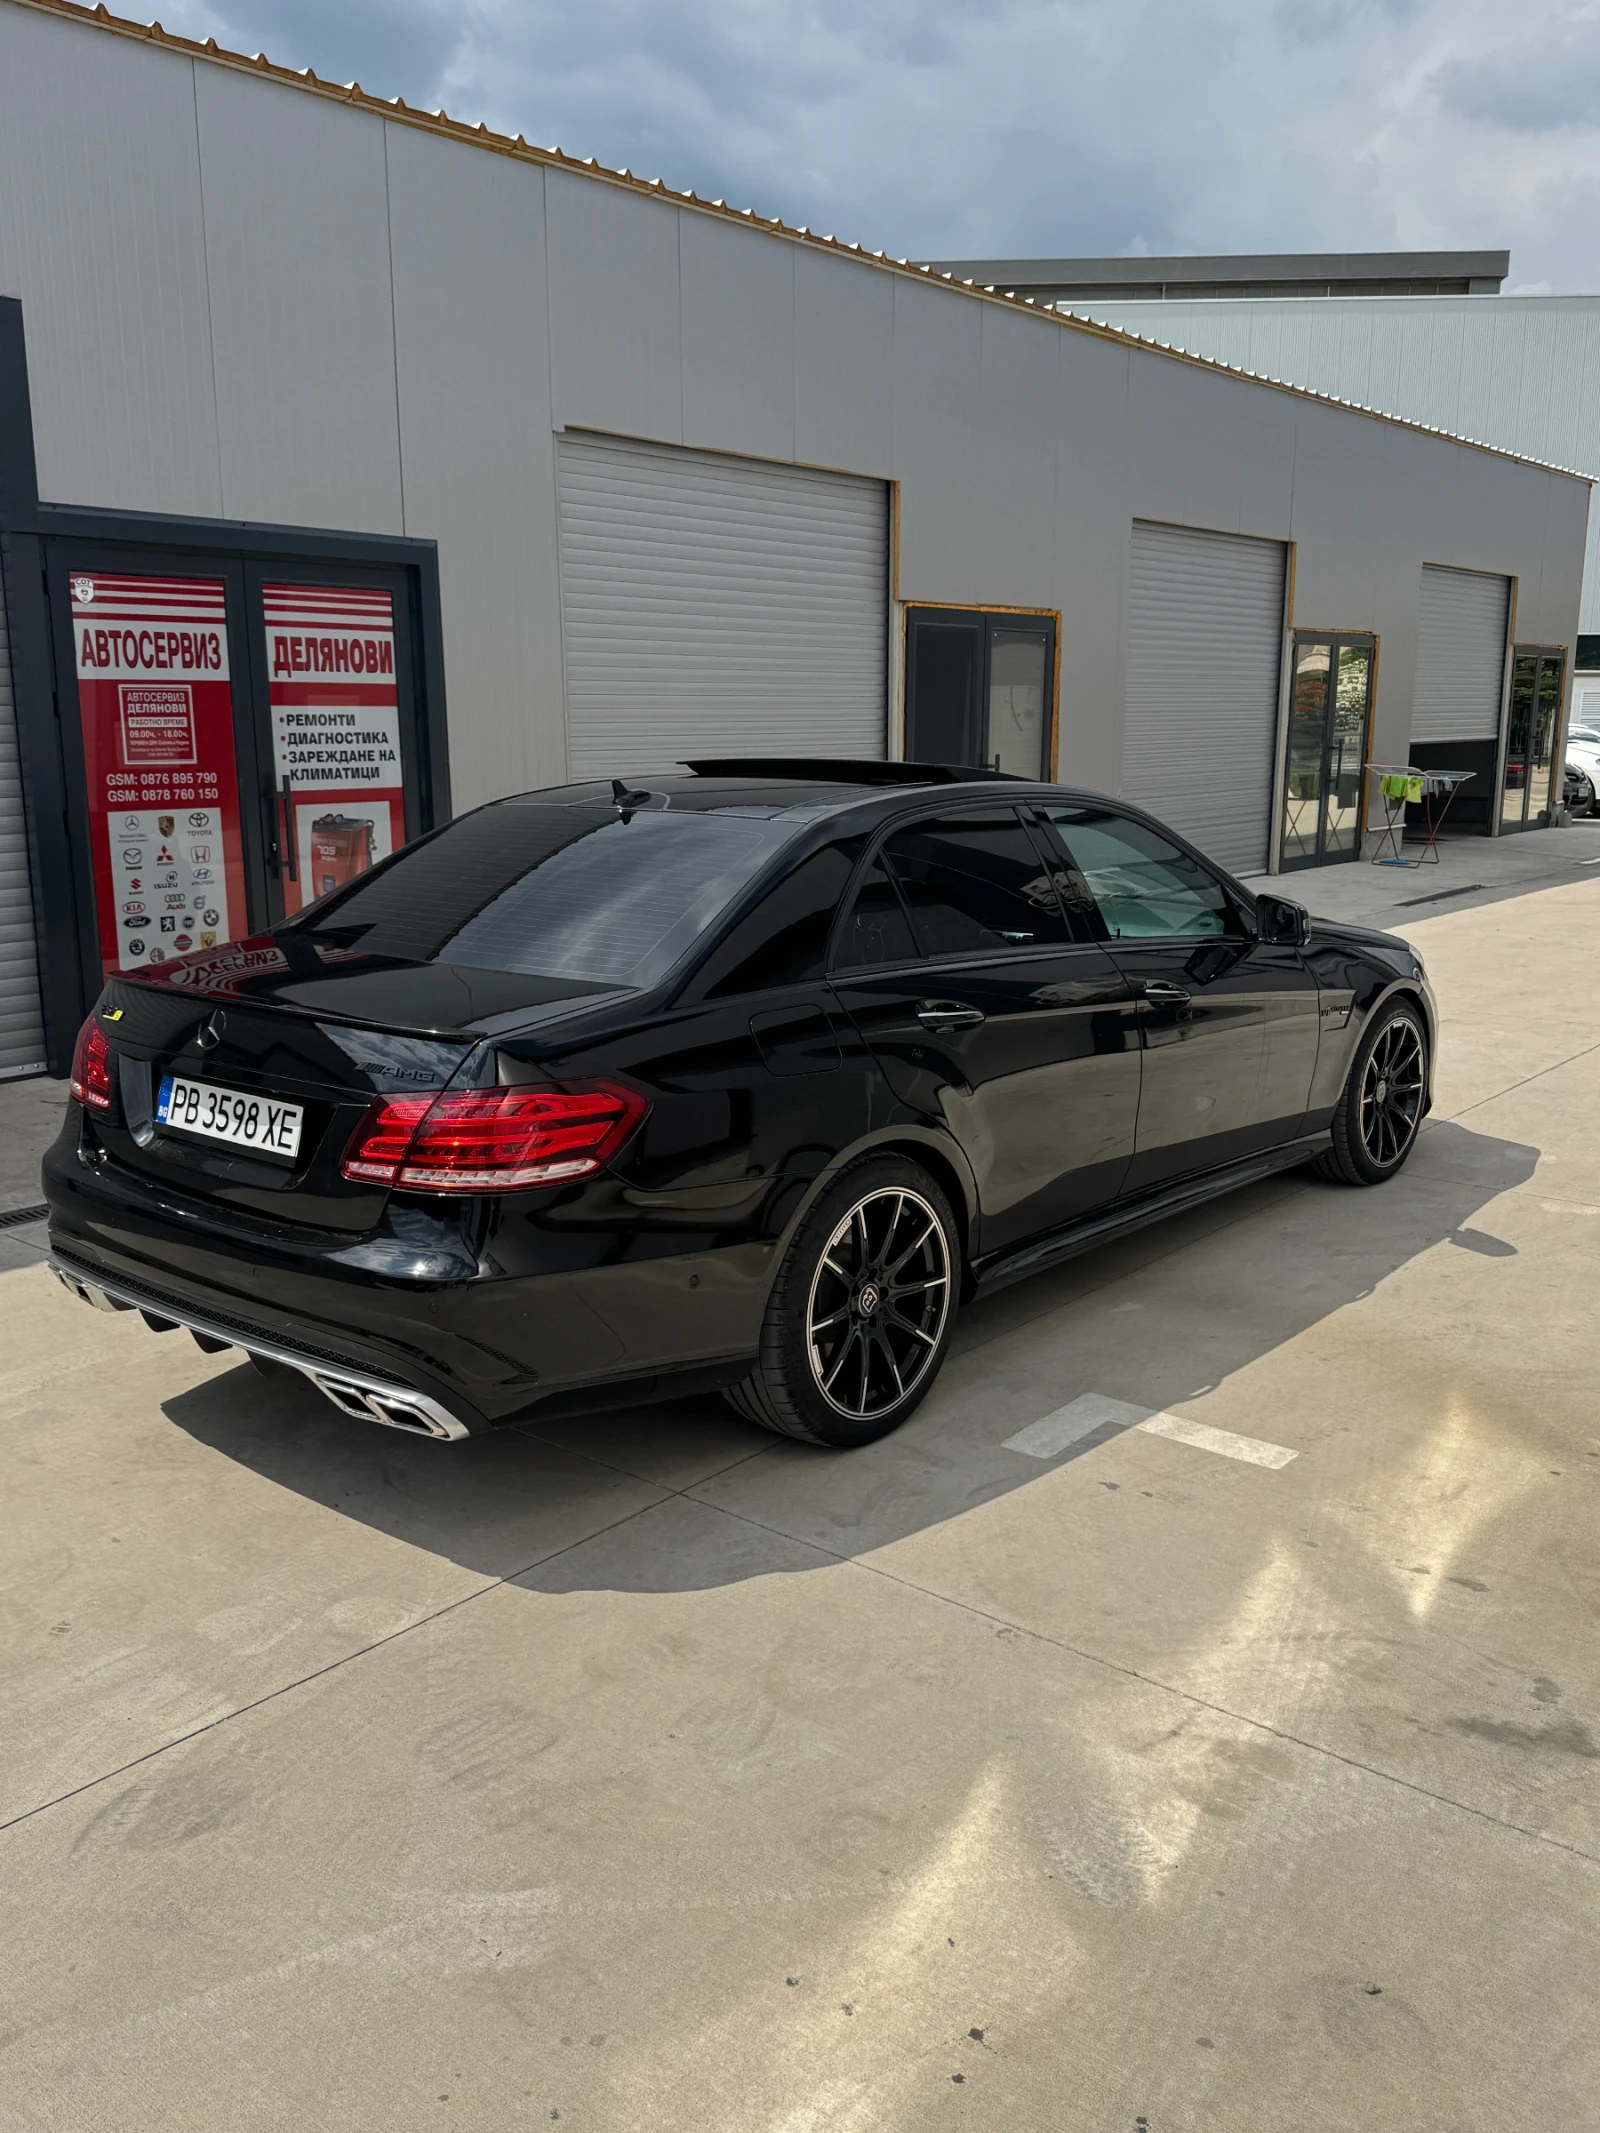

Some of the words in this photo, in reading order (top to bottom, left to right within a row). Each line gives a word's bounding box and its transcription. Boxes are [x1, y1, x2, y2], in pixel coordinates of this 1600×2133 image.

[81, 628, 222, 670] АВТОСЕРВИЗ
[273, 635, 394, 678] ДЕЛЯНОВИ
[127, 692, 186, 703] АВТОСЕРВИЗ
[127, 703, 187, 715] ДЕЛЯНОВИ
[131, 718, 162, 726] РАБОТНО
[163, 718, 186, 726] ВРЕМЕ
[286, 714, 356, 727] РЕМОНТИ
[287, 732, 389, 748] ДИАГНОСТИКА
[288, 750, 376, 765] ЗАРЕЖДАНЕ
[379, 750, 396, 762] НА
[106, 774, 138, 786] GSM:
[140, 773, 170, 785] 0876
[172, 773, 194, 784] 895
[196, 772, 218, 784] 790
[290, 767, 380, 781] КЛИМАТИЦИ
[107, 790, 139, 802] GSM:
[141, 789, 171, 801] 0878
[173, 788, 195, 800] 760
[198, 788, 219, 799] 150
[126, 904, 143, 912] KIA
[381, 1066, 435, 1083] AMG
[157, 1105, 168, 1117] BG
[170, 1084, 200, 1124] PB
[202, 1093, 260, 1139] 3598
[261, 1105, 297, 1149] XE
